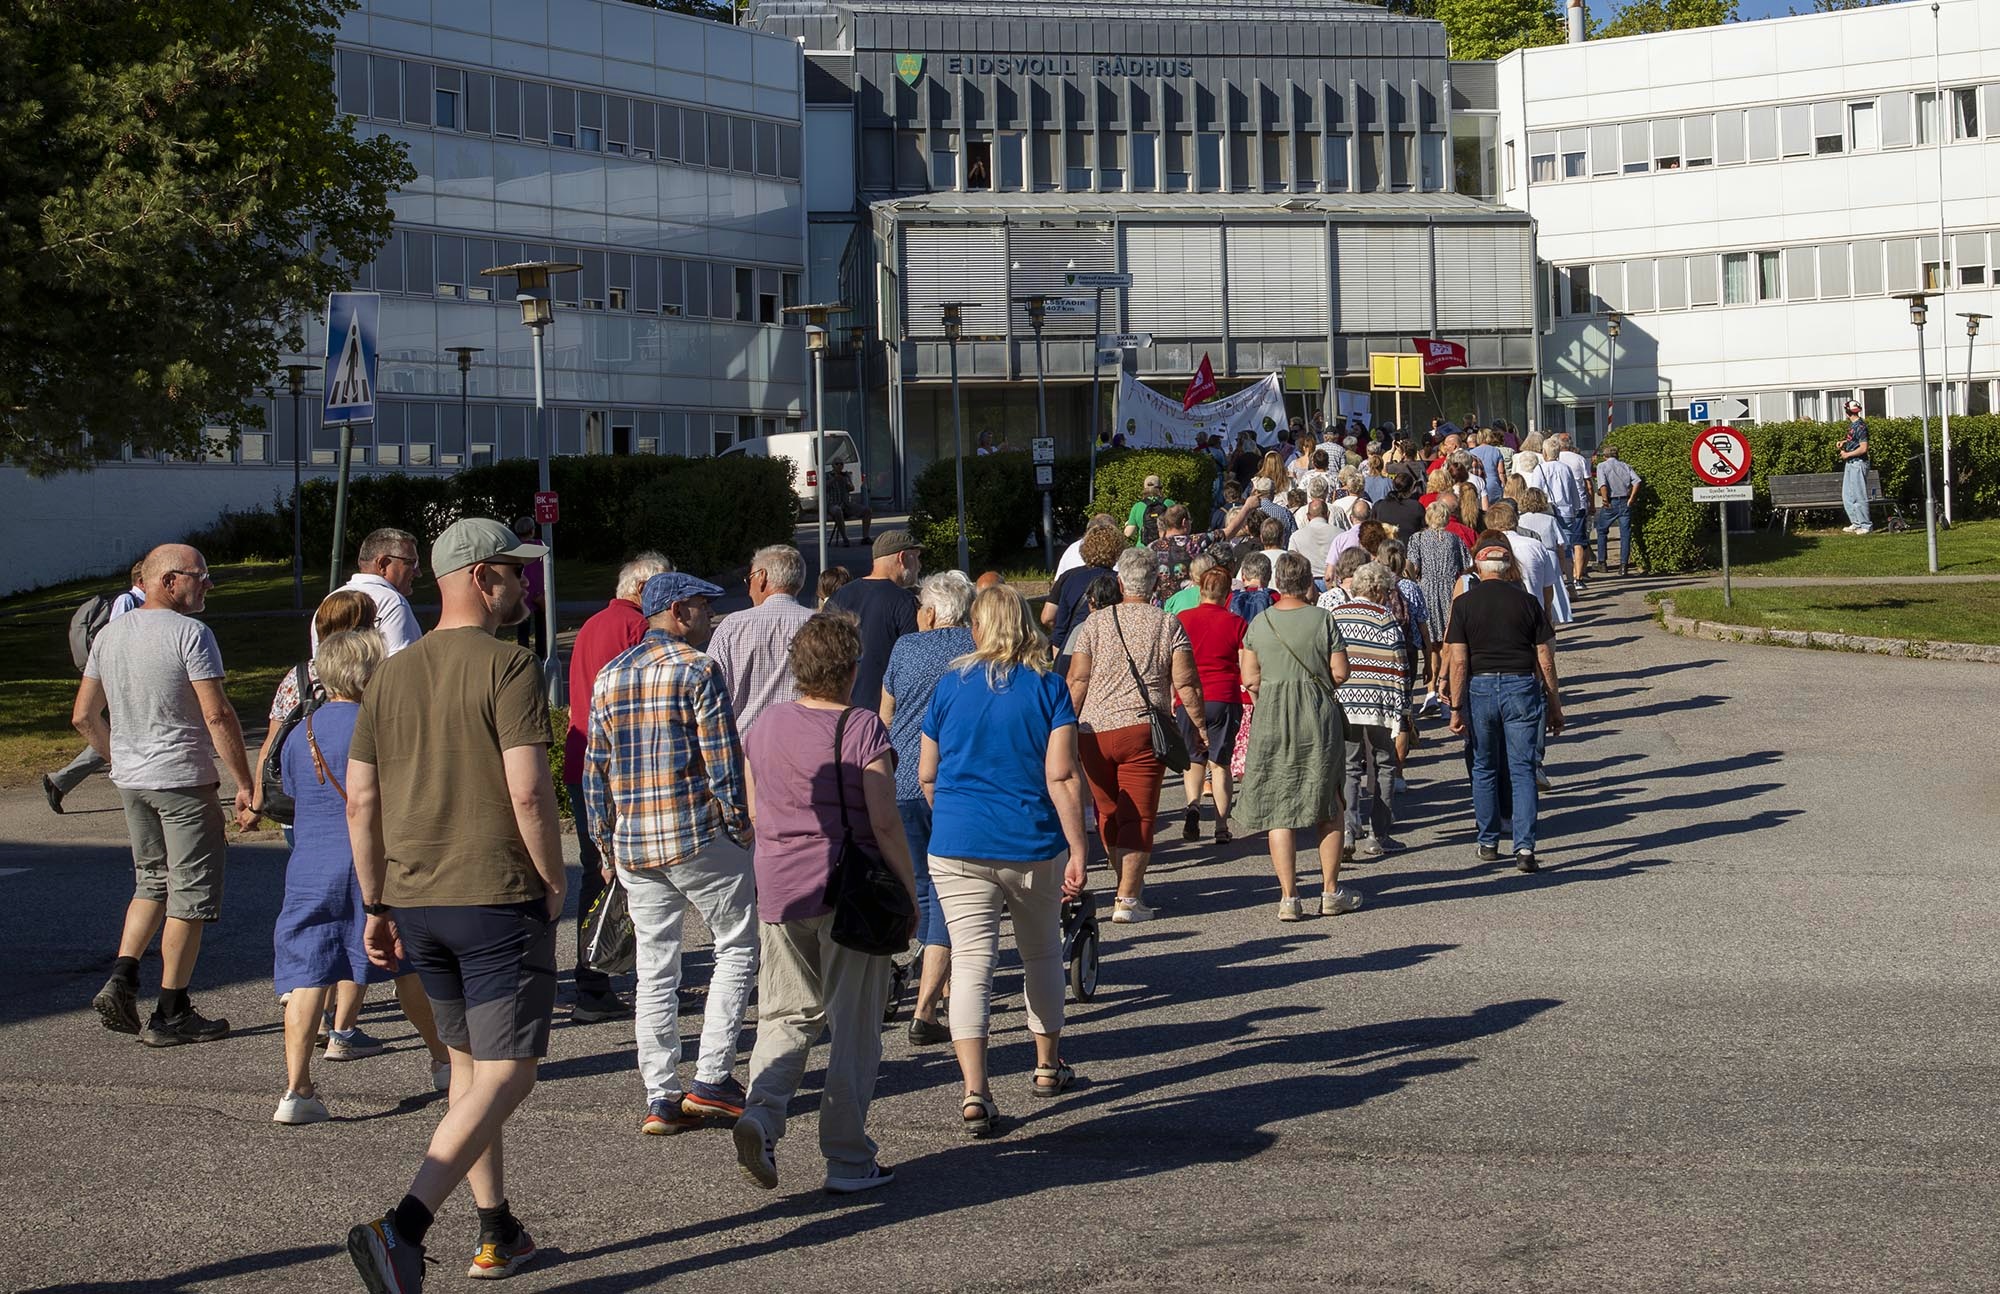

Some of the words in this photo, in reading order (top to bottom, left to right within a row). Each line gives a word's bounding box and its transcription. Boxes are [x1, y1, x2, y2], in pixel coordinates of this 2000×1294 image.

[948, 57, 1077, 76] EIDSVOLL
[1094, 55, 1192, 77] RÅDHUS
[1694, 404, 1704, 418] P
[536, 496, 547, 504] BK
[381, 1223, 396, 1249] HOKA
